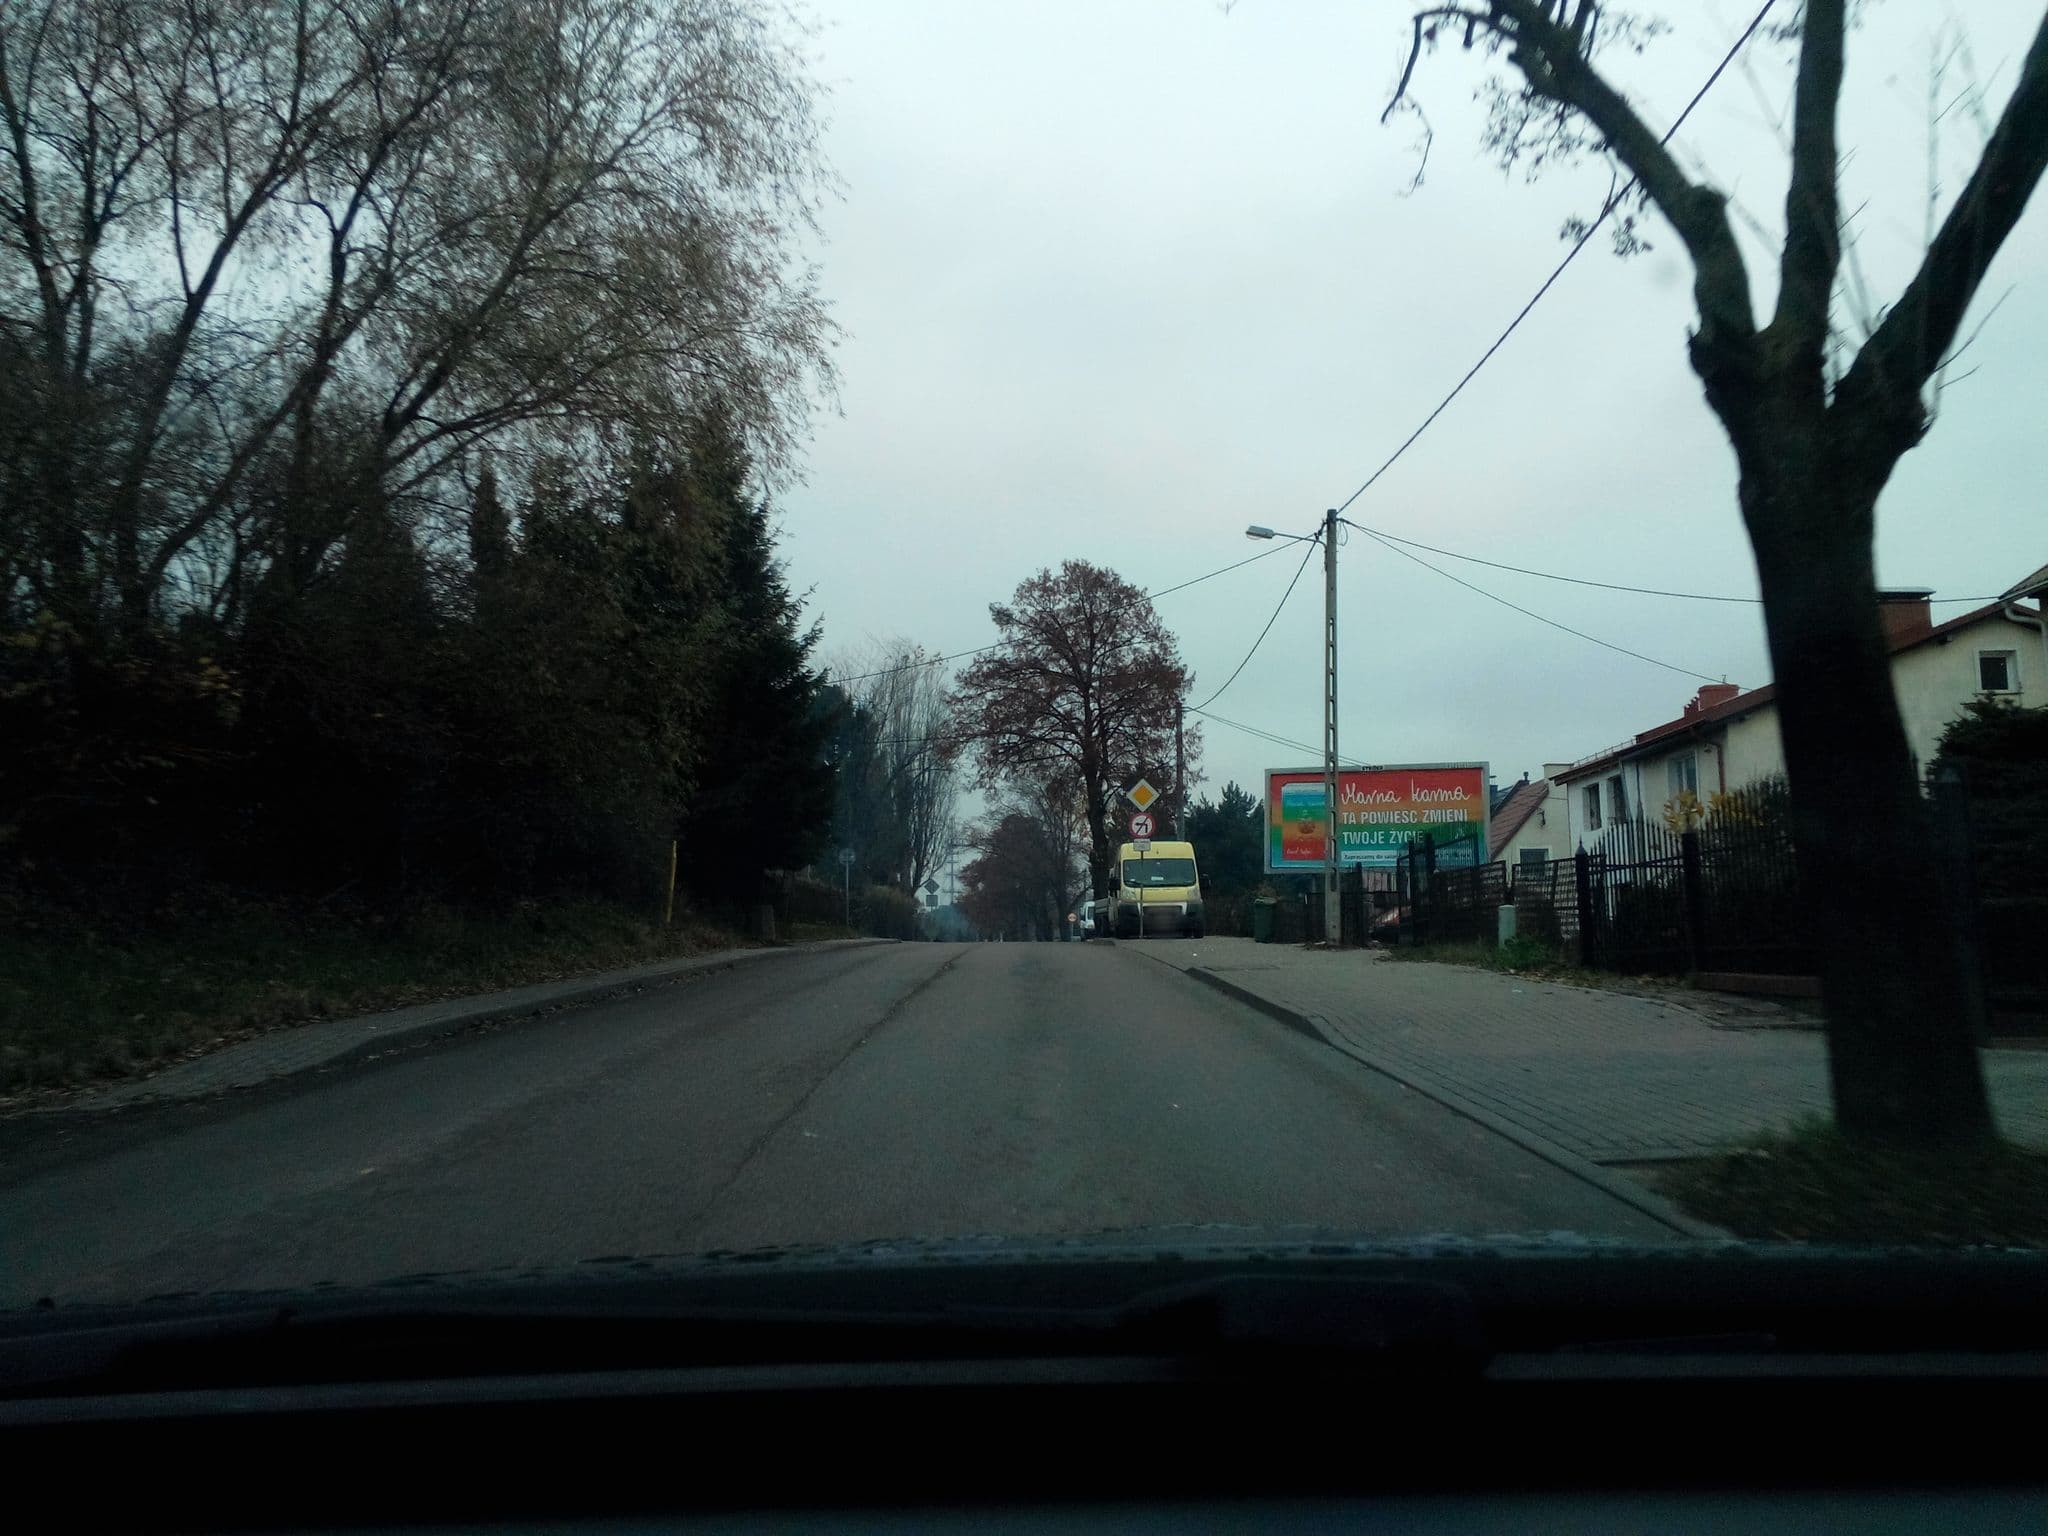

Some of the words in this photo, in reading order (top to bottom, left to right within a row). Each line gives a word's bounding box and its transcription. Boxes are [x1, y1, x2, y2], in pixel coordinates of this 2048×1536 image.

[1411, 777, 1472, 802] karma
[1342, 812, 1356, 825] TA
[1422, 809, 1468, 823] ZMIENI
[1343, 831, 1385, 845] TWOJE
